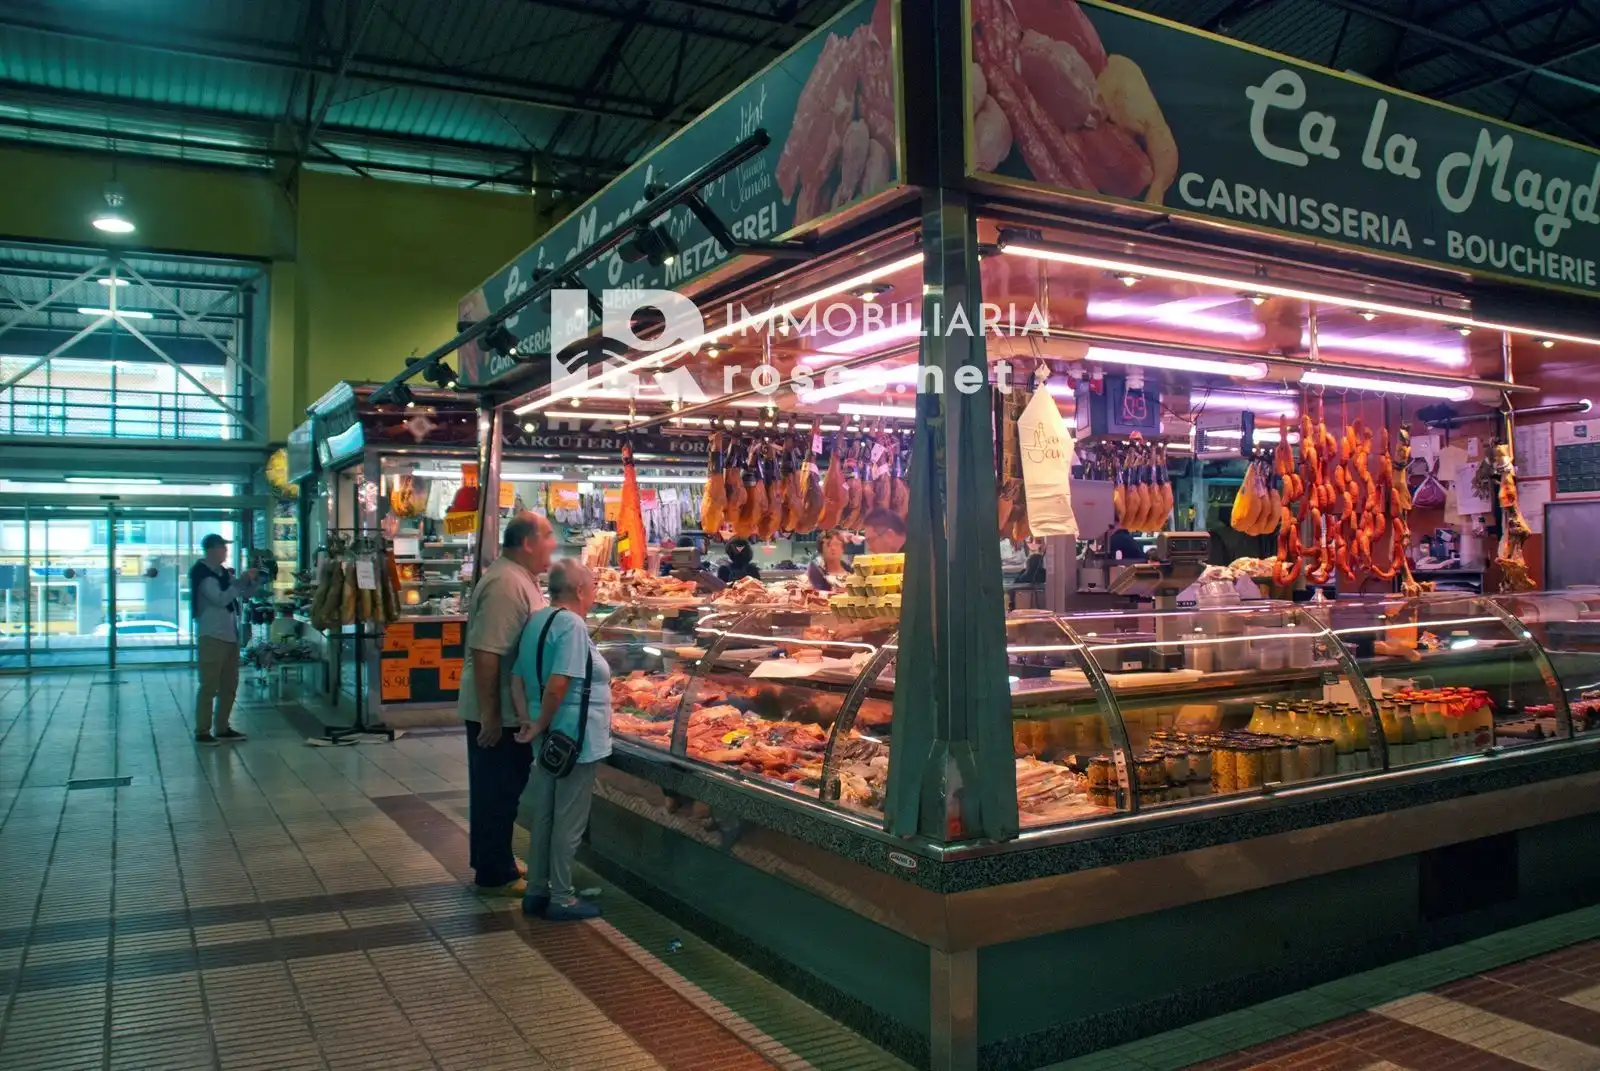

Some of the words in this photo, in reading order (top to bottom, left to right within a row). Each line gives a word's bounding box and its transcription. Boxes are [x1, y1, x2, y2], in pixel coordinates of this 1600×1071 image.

[1244, 68, 1341, 167] Ca
[1360, 97, 1421, 180] la
[1177, 171, 1413, 250] CARNISSERIA
[1446, 229, 1598, 287] BOUCHERIE
[501, 434, 632, 449] XARCUTERI
